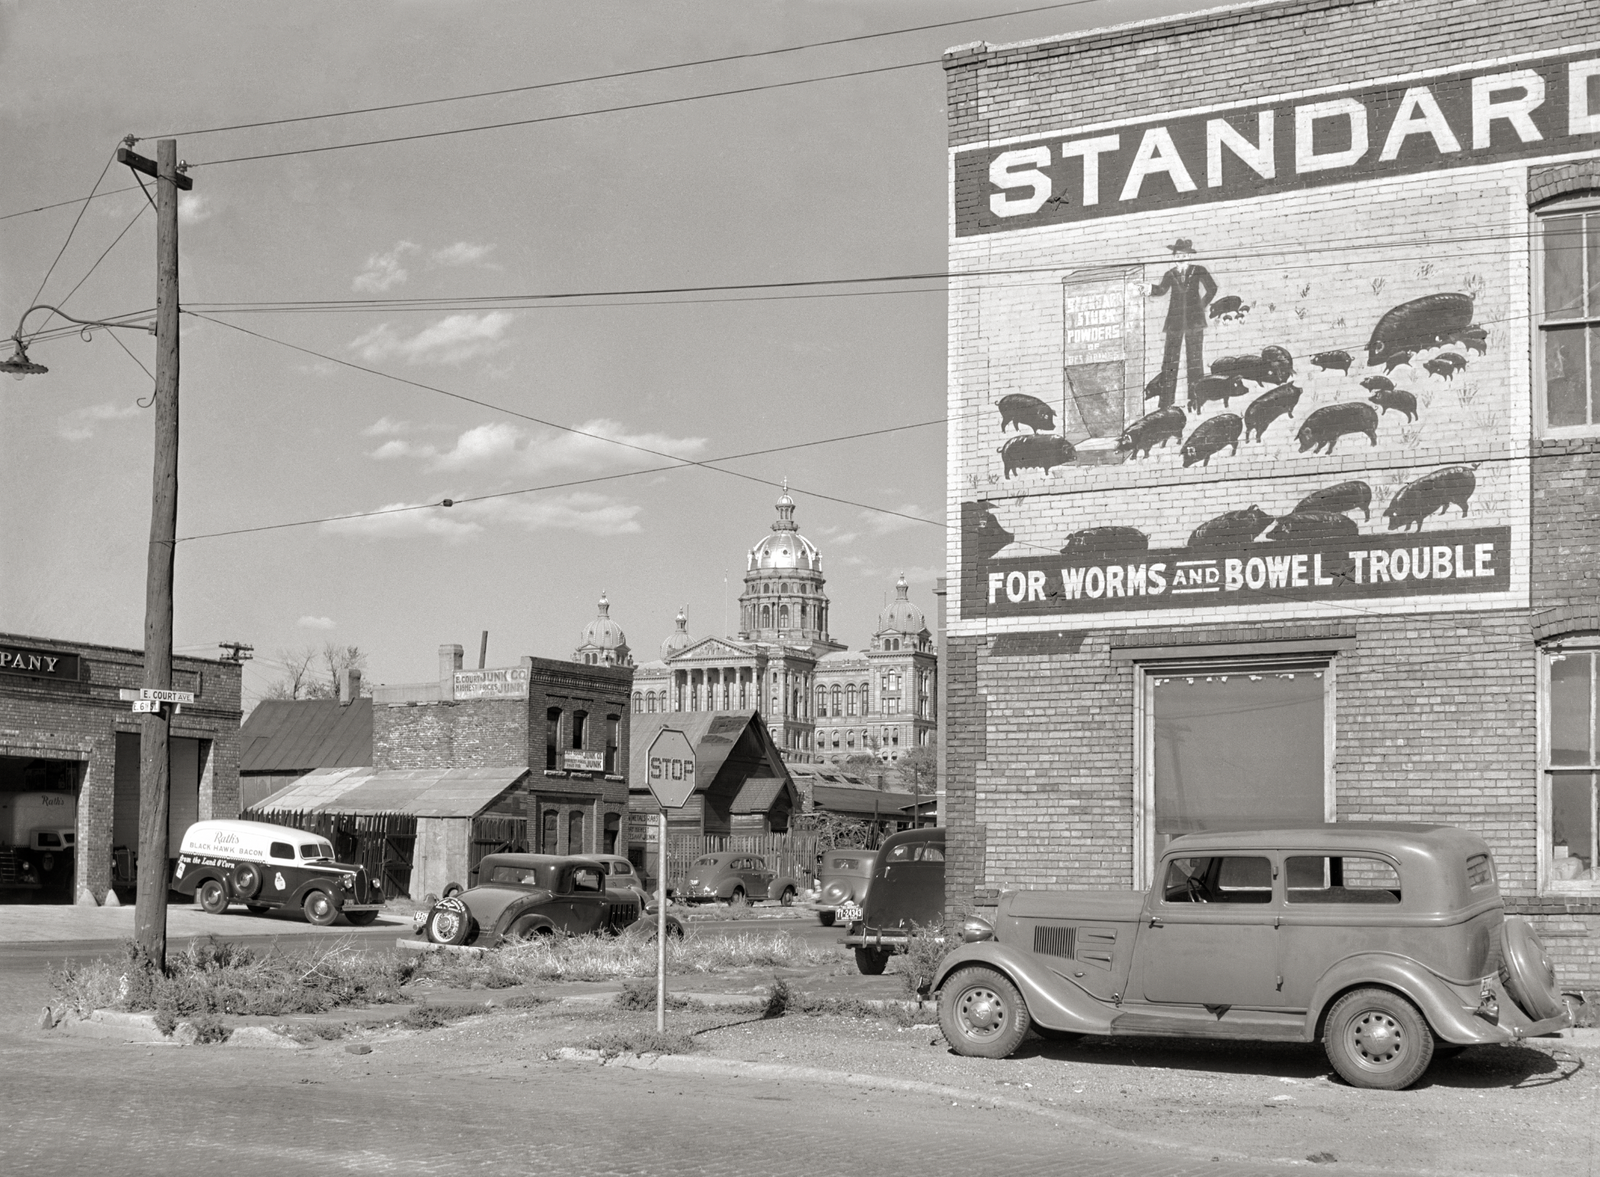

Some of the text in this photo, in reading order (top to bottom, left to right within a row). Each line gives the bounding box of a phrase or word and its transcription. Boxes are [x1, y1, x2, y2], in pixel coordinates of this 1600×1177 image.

[1067, 324, 1120, 343] POWDERS
[988, 543, 1495, 604] FOR WORMS AND BOWEL TROUBLE
[461, 675, 481, 684] COURT
[481, 670, 508, 682] JUNK
[498, 682, 525, 694] JUNK
[143, 690, 151, 699] E.
[152, 691, 177, 701] COURT
[586, 760, 602, 769] JUNK
[650, 756, 694, 781] STOP
[41, 795, 65, 807] Rath's
[213, 831, 240, 844] Rath's
[189, 842, 263, 856] BLACK HAWK BACON
[192, 856, 201, 864] the
[201, 857, 217, 866] Land
